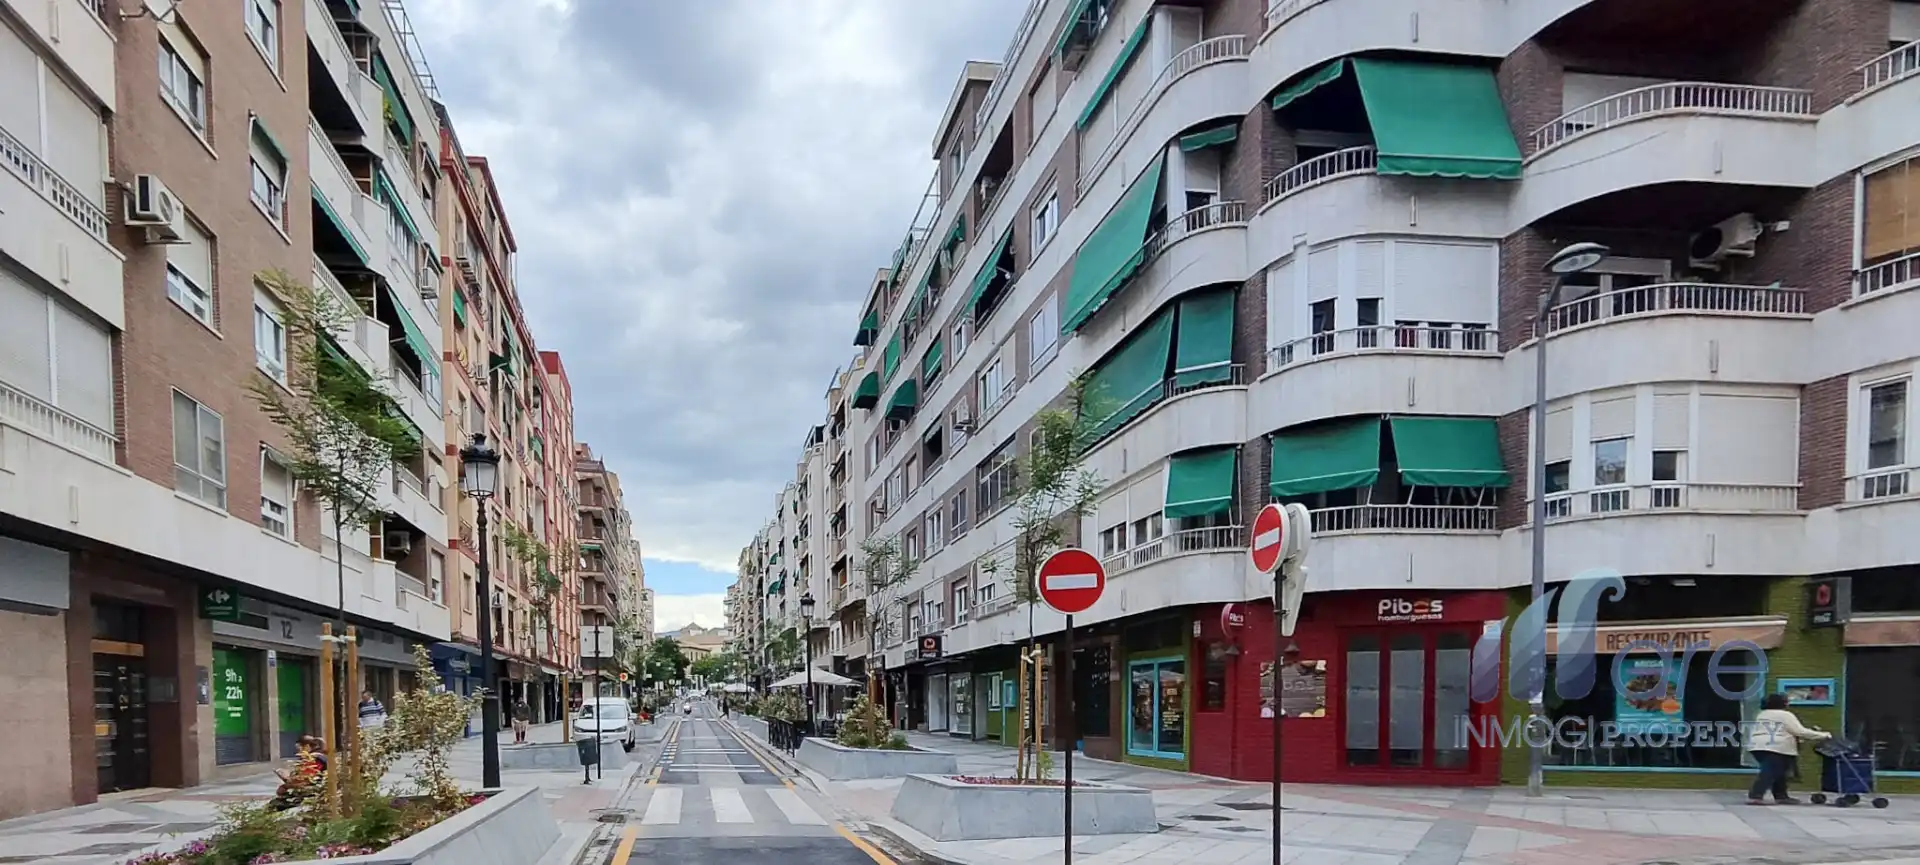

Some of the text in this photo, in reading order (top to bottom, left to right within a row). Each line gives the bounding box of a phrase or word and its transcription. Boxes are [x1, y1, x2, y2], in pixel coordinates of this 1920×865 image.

[280, 620, 294, 639] 12
[1606, 631, 1711, 650] RESTAURANTE
[225, 668, 237, 683] 9h
[225, 686, 243, 699] 22h
